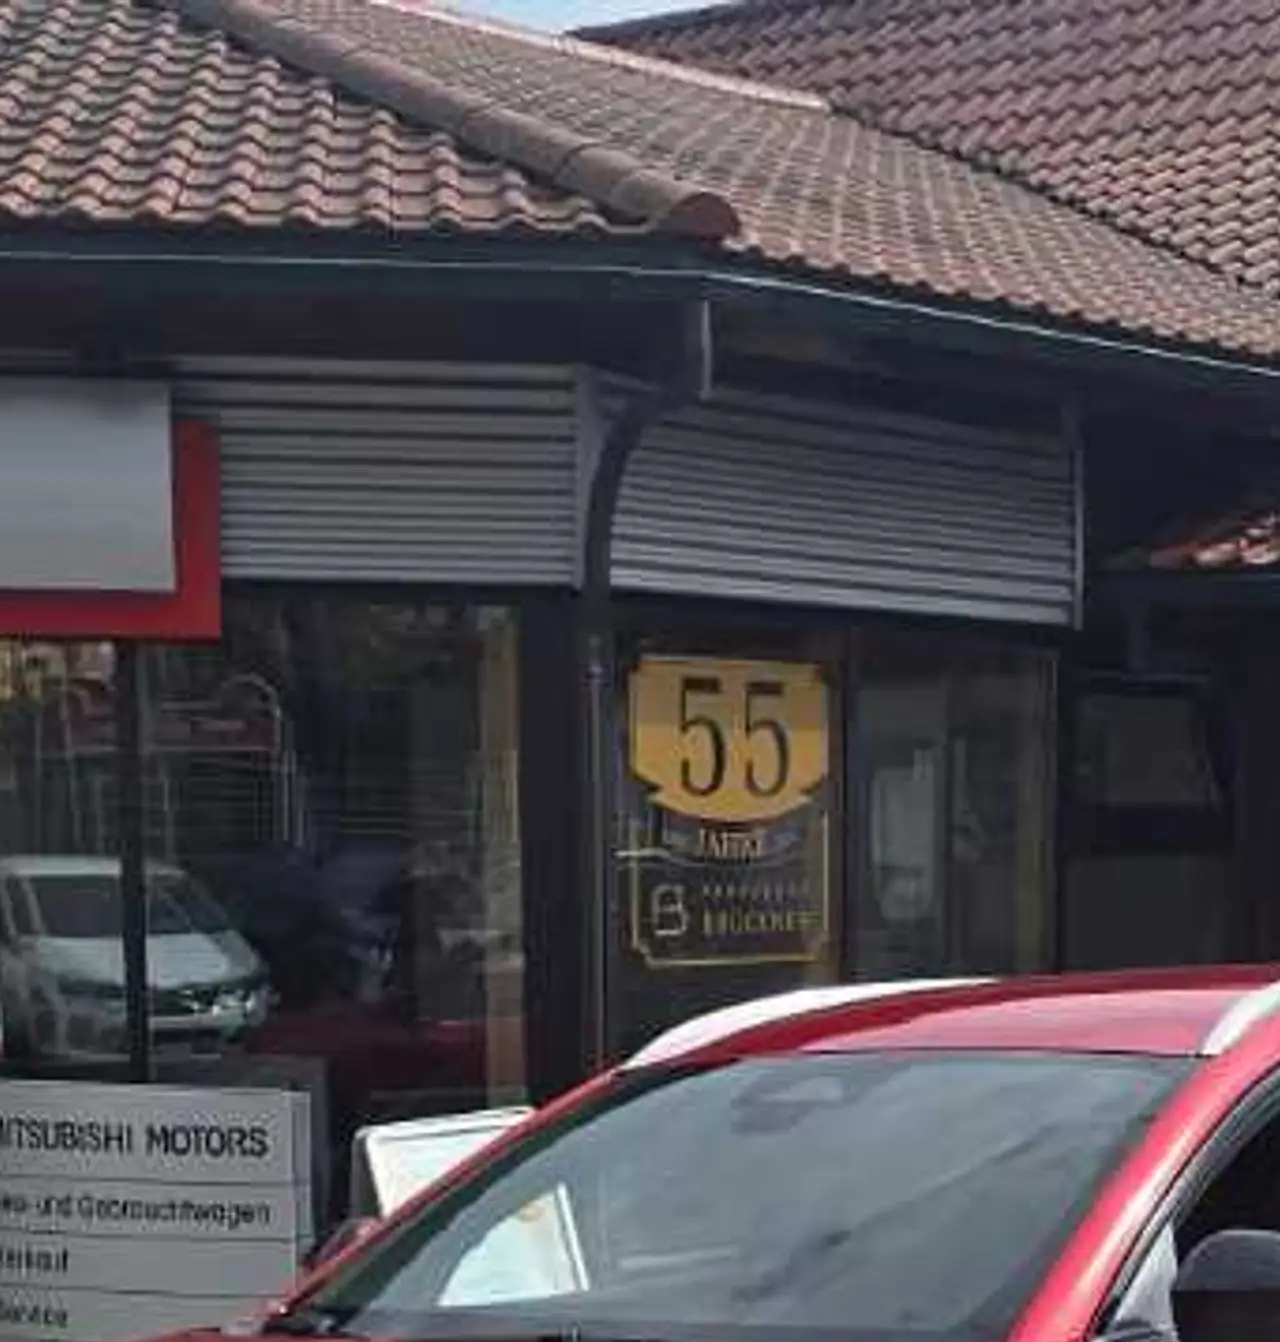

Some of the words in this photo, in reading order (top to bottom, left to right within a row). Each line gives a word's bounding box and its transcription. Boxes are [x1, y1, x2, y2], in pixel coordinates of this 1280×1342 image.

[680, 675, 790, 798] 55
[145, 1123, 270, 1159] MOTORS
[76, 1193, 271, 1231] Gebrauchtwagen
